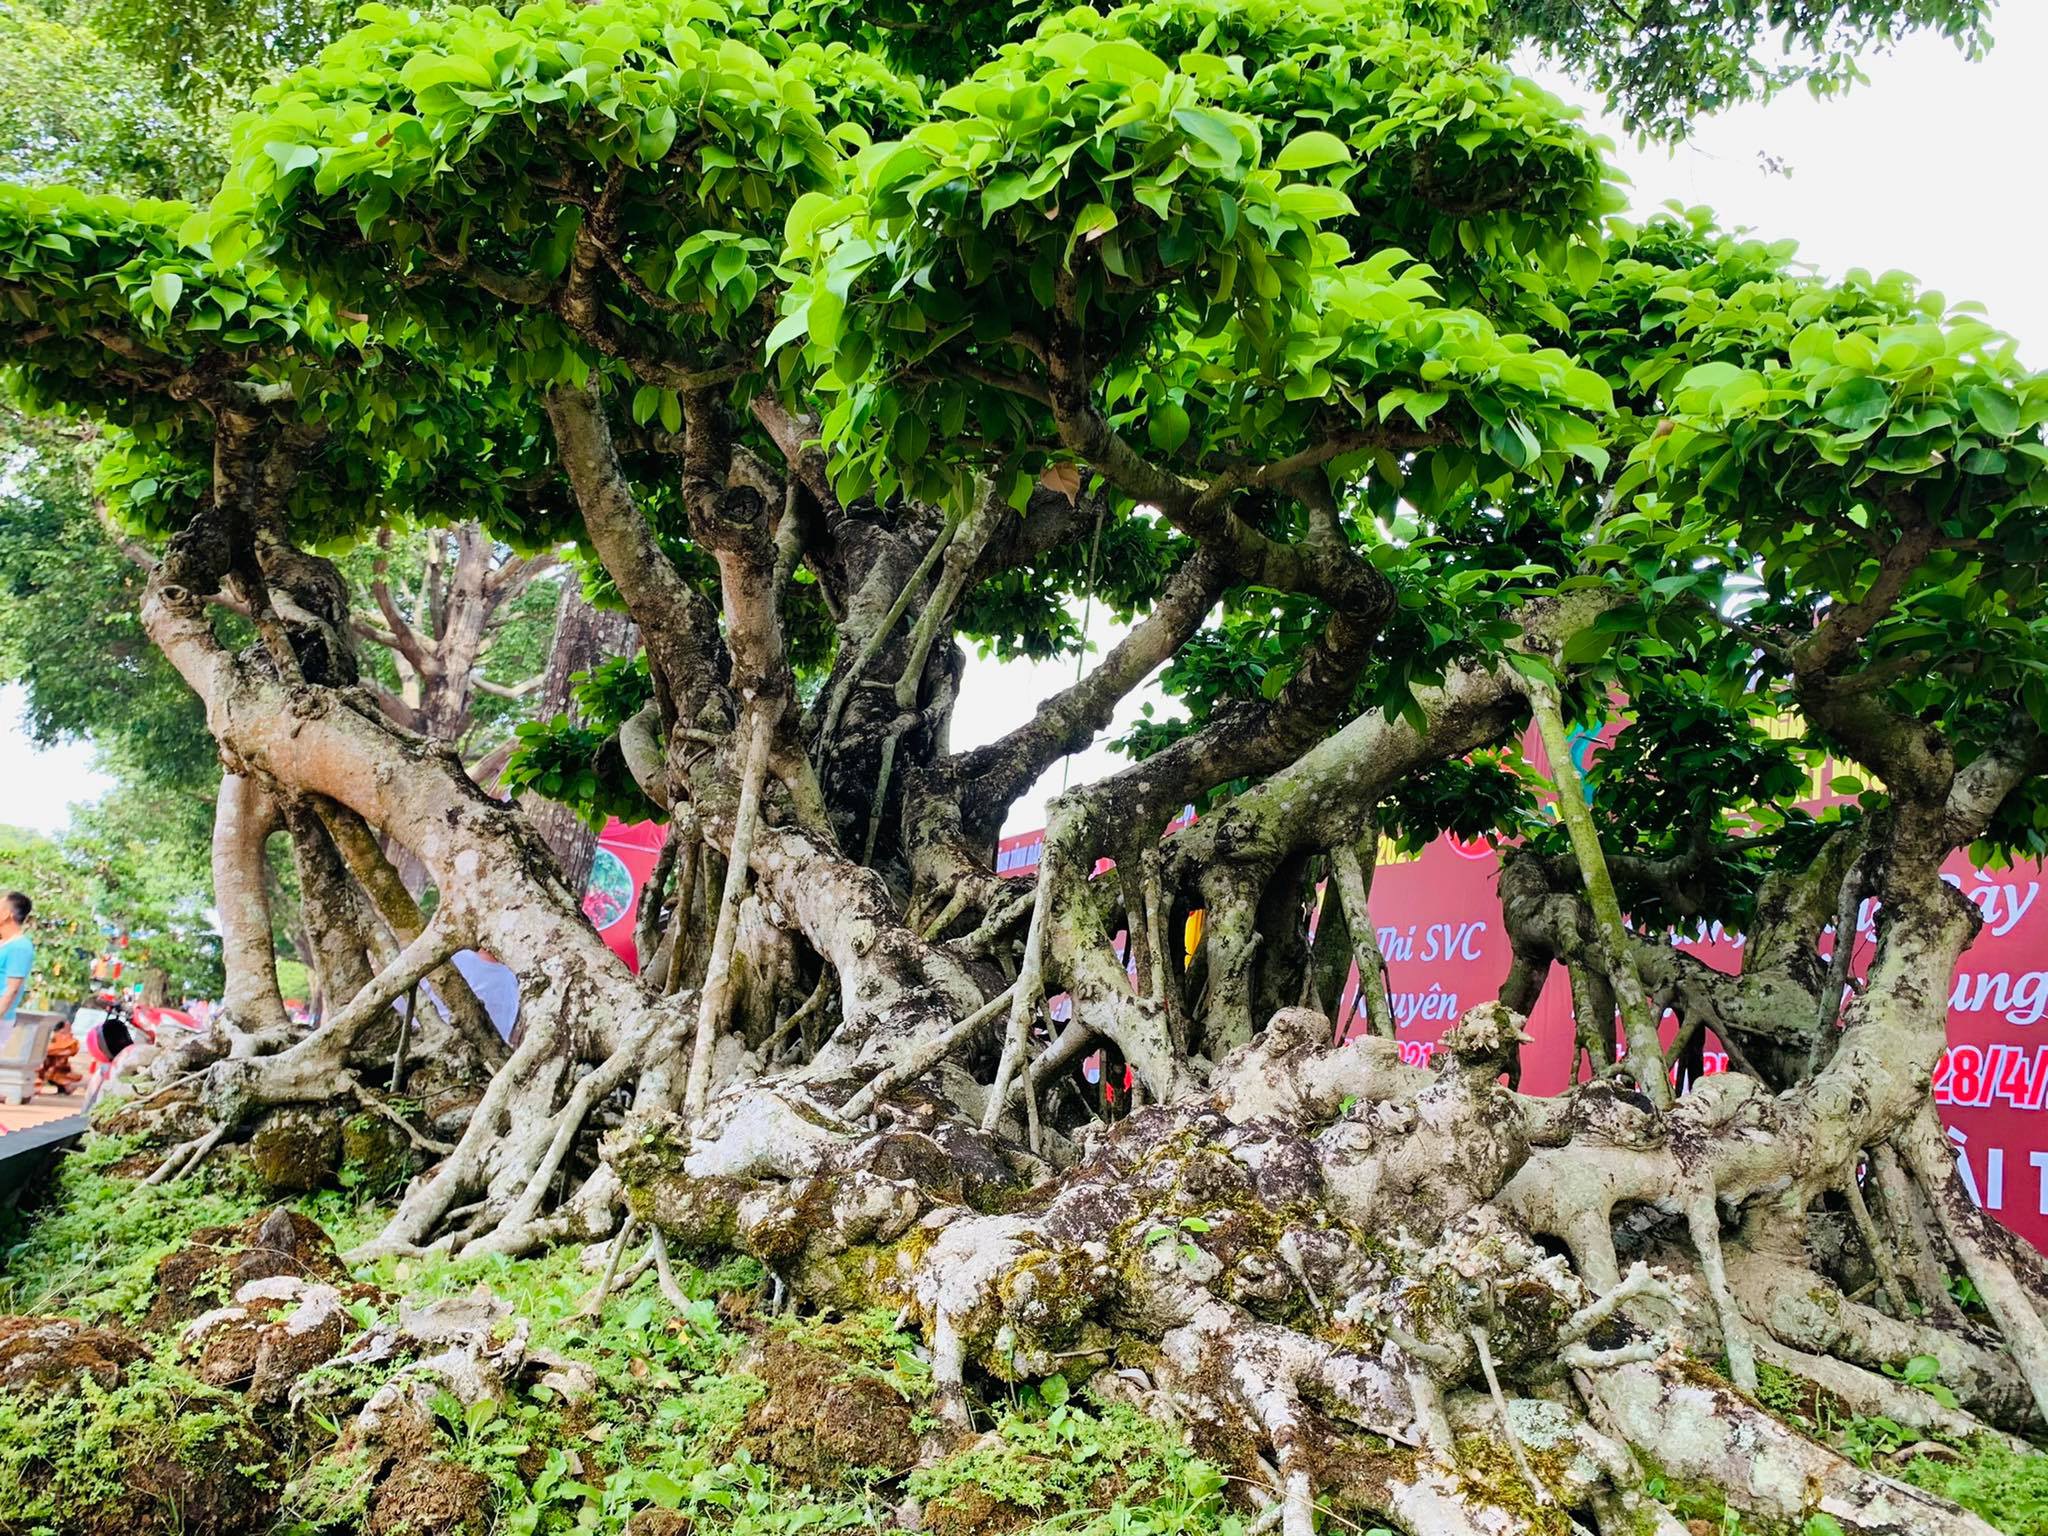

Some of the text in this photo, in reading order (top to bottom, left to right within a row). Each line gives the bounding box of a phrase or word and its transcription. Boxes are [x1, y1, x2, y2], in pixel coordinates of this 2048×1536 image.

[1375, 834, 1421, 866] 202
[1939, 869, 2040, 937] ày
[1420, 921, 1487, 962] SVC
[1947, 970, 2048, 1025] ung
[1931, 1044, 2048, 1110] 28/4/
